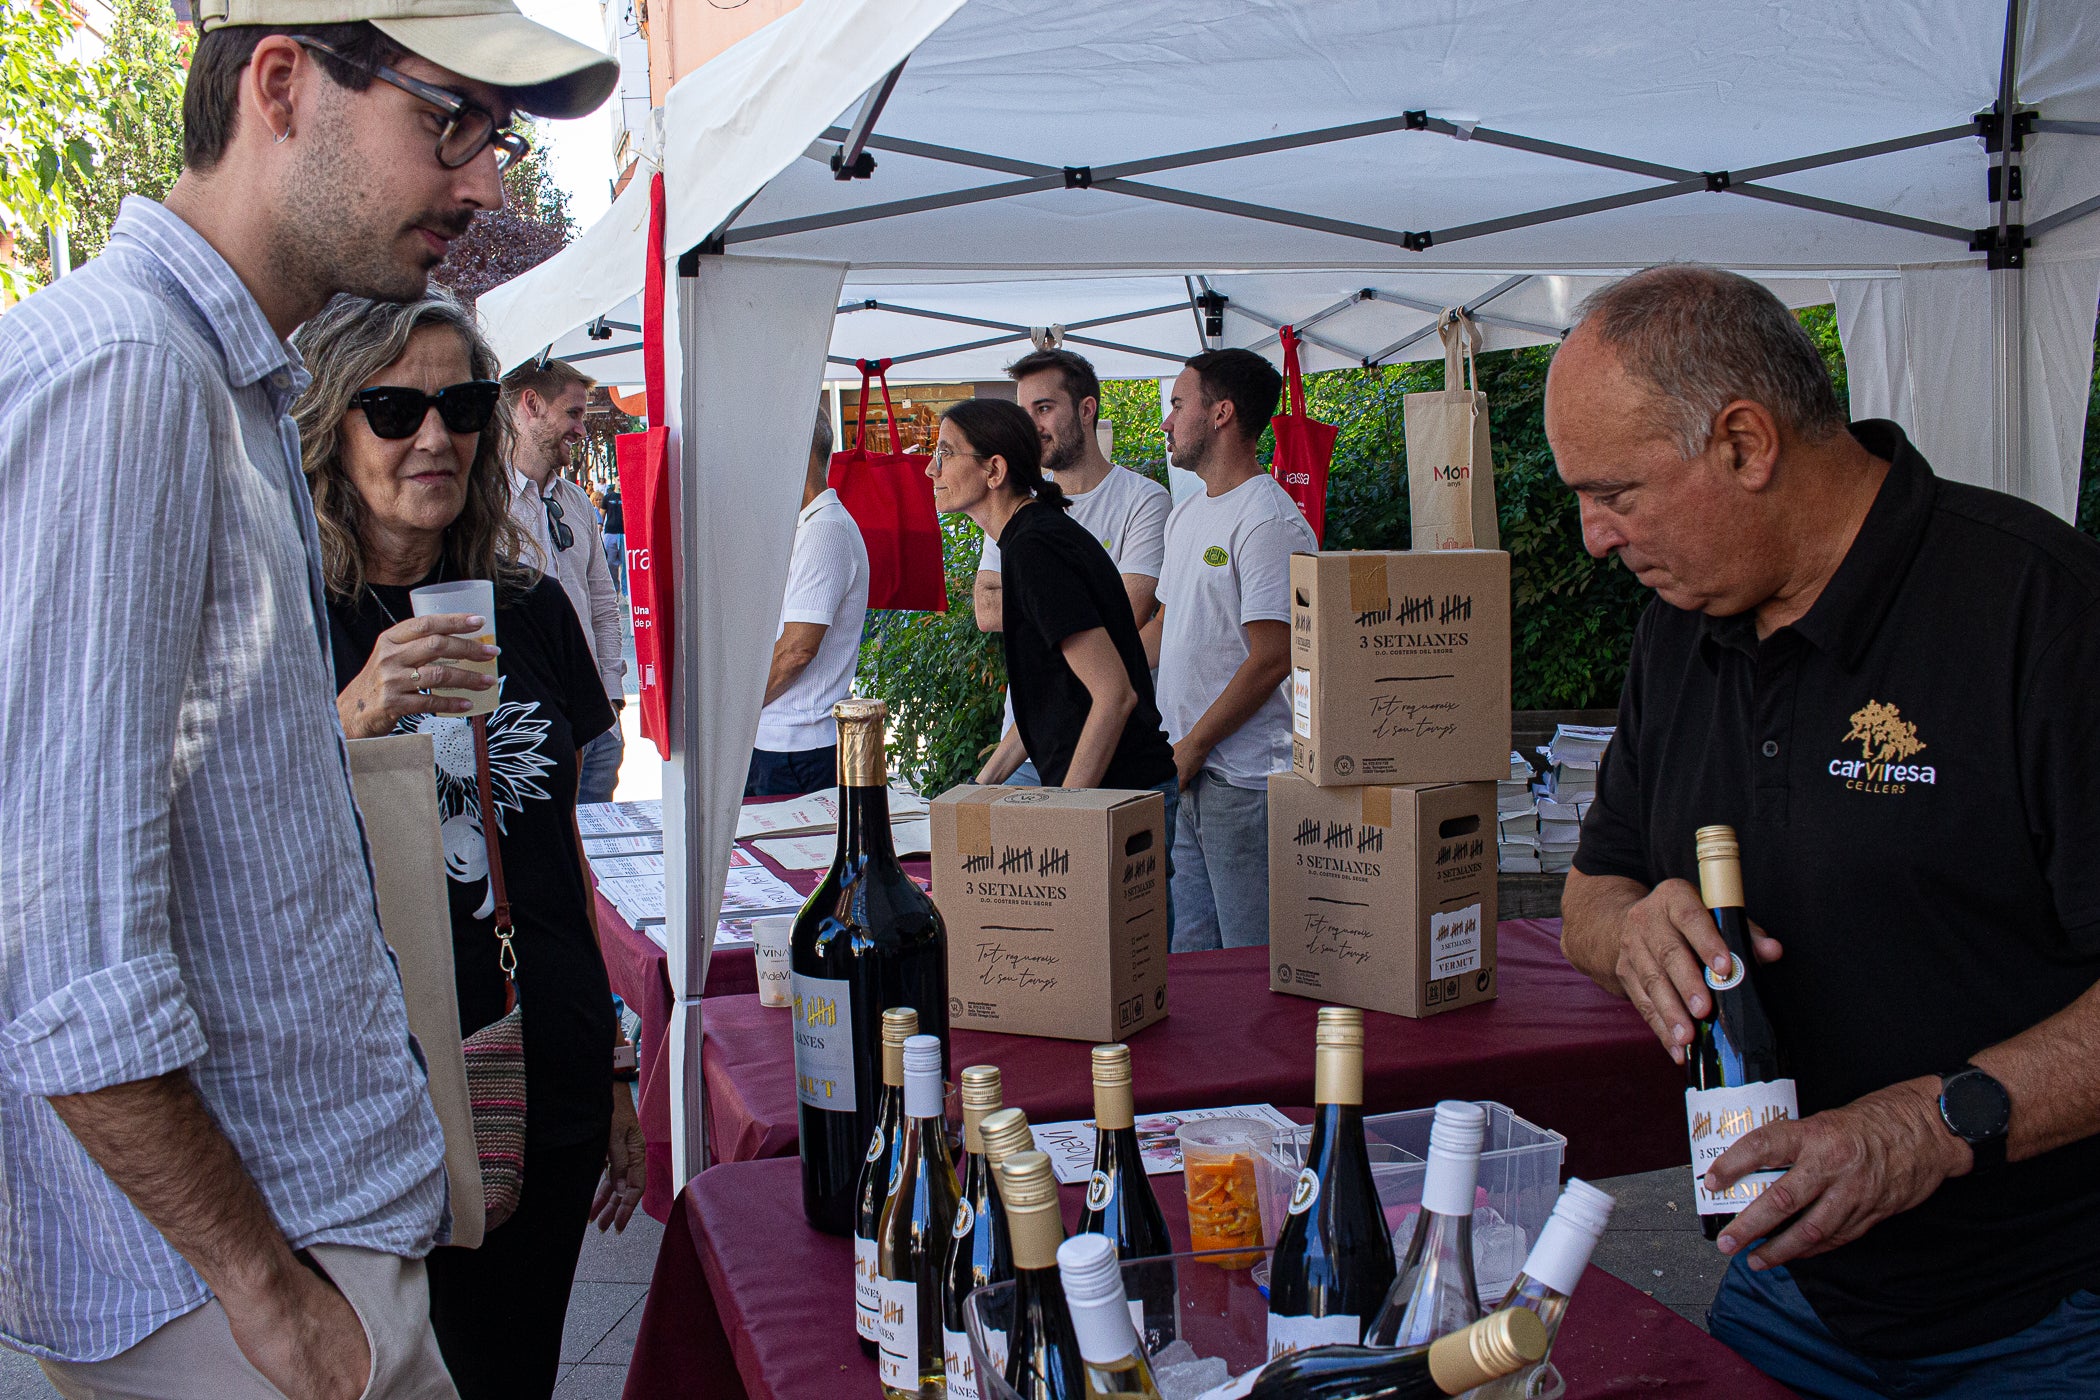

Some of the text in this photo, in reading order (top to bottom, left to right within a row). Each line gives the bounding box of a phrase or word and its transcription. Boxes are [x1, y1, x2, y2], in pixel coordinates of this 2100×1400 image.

[634, 606, 649, 615] Una
[635, 618, 644, 627] de
[1360, 632, 1469, 648] 3 SETMANES
[1369, 695, 1403, 717] Tot
[1846, 780, 1906, 794] CELLERS
[1297, 854, 1381, 877] 3 SETMANES
[1443, 863, 1482, 879] SETMANES
[966, 882, 1067, 900] 3 SETMANES
[1304, 914, 1328, 933] Tot
[1445, 938, 1472, 949] SETMANES
[976, 942, 1007, 963] Tot
[1439, 956, 1474, 972] VERMUT
[1700, 1149, 1705, 1159] 3
